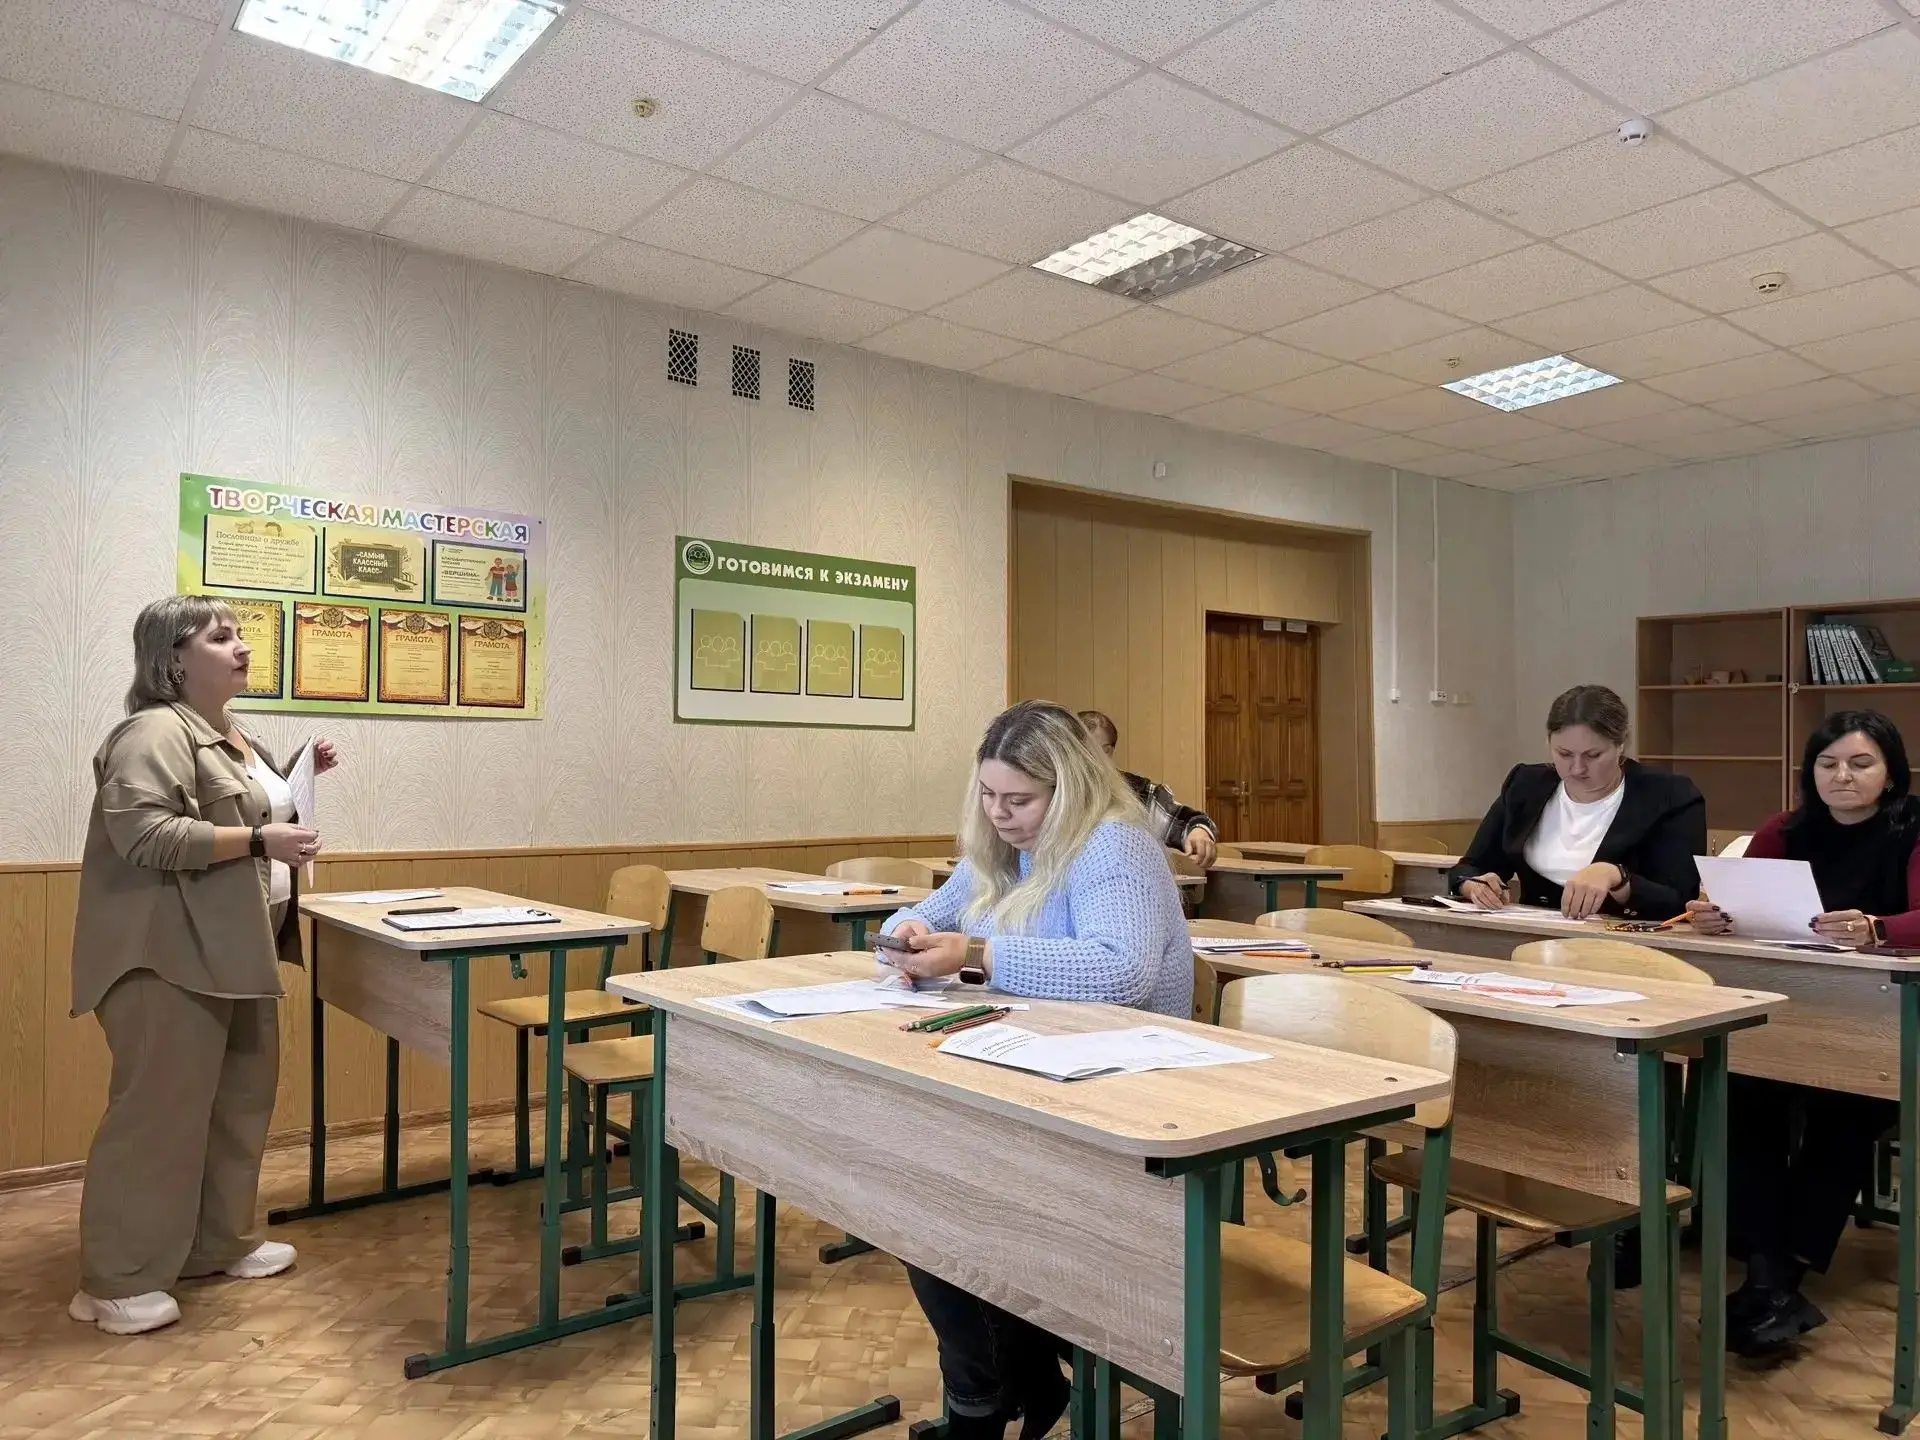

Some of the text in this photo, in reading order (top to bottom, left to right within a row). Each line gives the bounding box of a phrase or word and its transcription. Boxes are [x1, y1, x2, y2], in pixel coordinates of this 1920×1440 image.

[209, 487, 528, 542] ТВОРЧЕСКАЯ МАСТЕРСКАЯ
[717, 556, 909, 591] ГОТОВИМСЯ К ЭКЗАМЕНУ
[311, 629, 353, 639] ГРАМОТА
[395, 634, 434, 644] ГРАМОТА
[474, 640, 510, 650] ГРАМОТА
